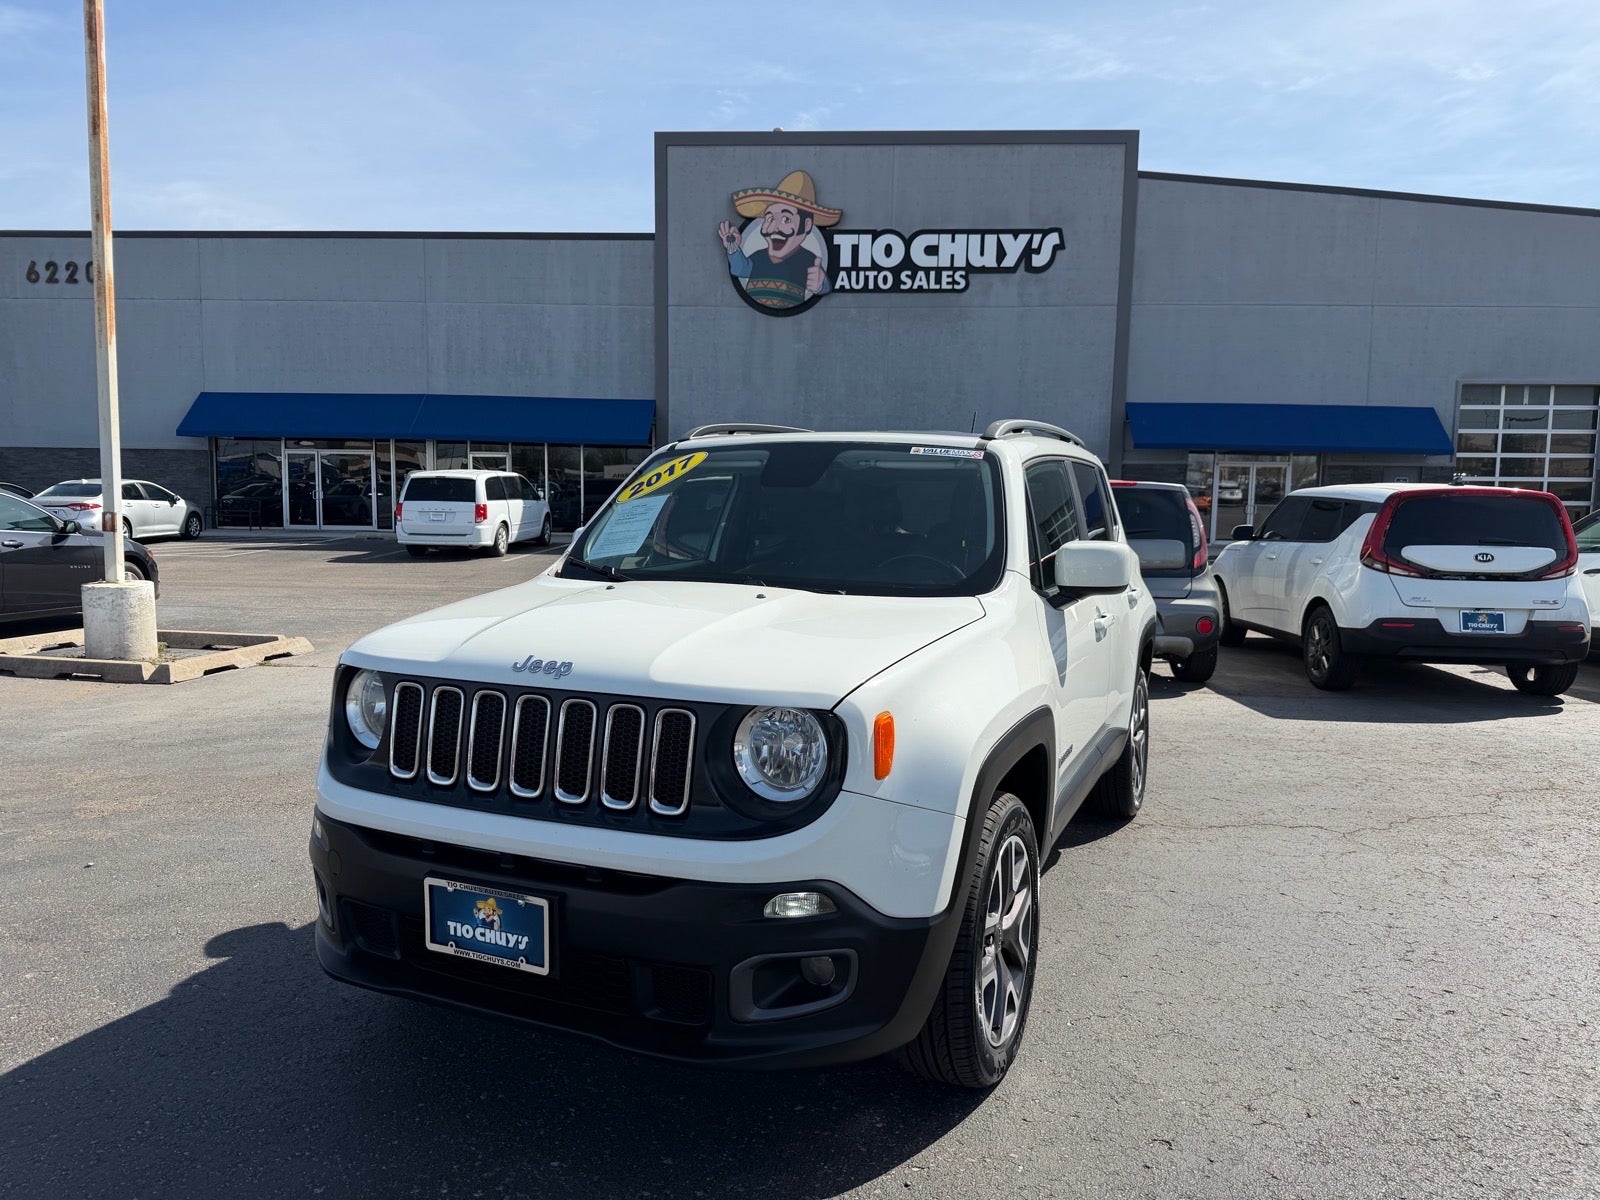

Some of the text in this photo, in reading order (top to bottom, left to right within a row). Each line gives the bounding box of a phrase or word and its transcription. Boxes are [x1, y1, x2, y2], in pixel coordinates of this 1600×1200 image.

[833, 232, 1060, 268] TIO CHUY'S
[834, 271, 966, 290] AUTO SALES
[628, 454, 695, 499] 2017
[1477, 554, 1493, 562] KIA
[512, 654, 574, 679] Jeep
[447, 920, 529, 950] TIO CHUY'S
